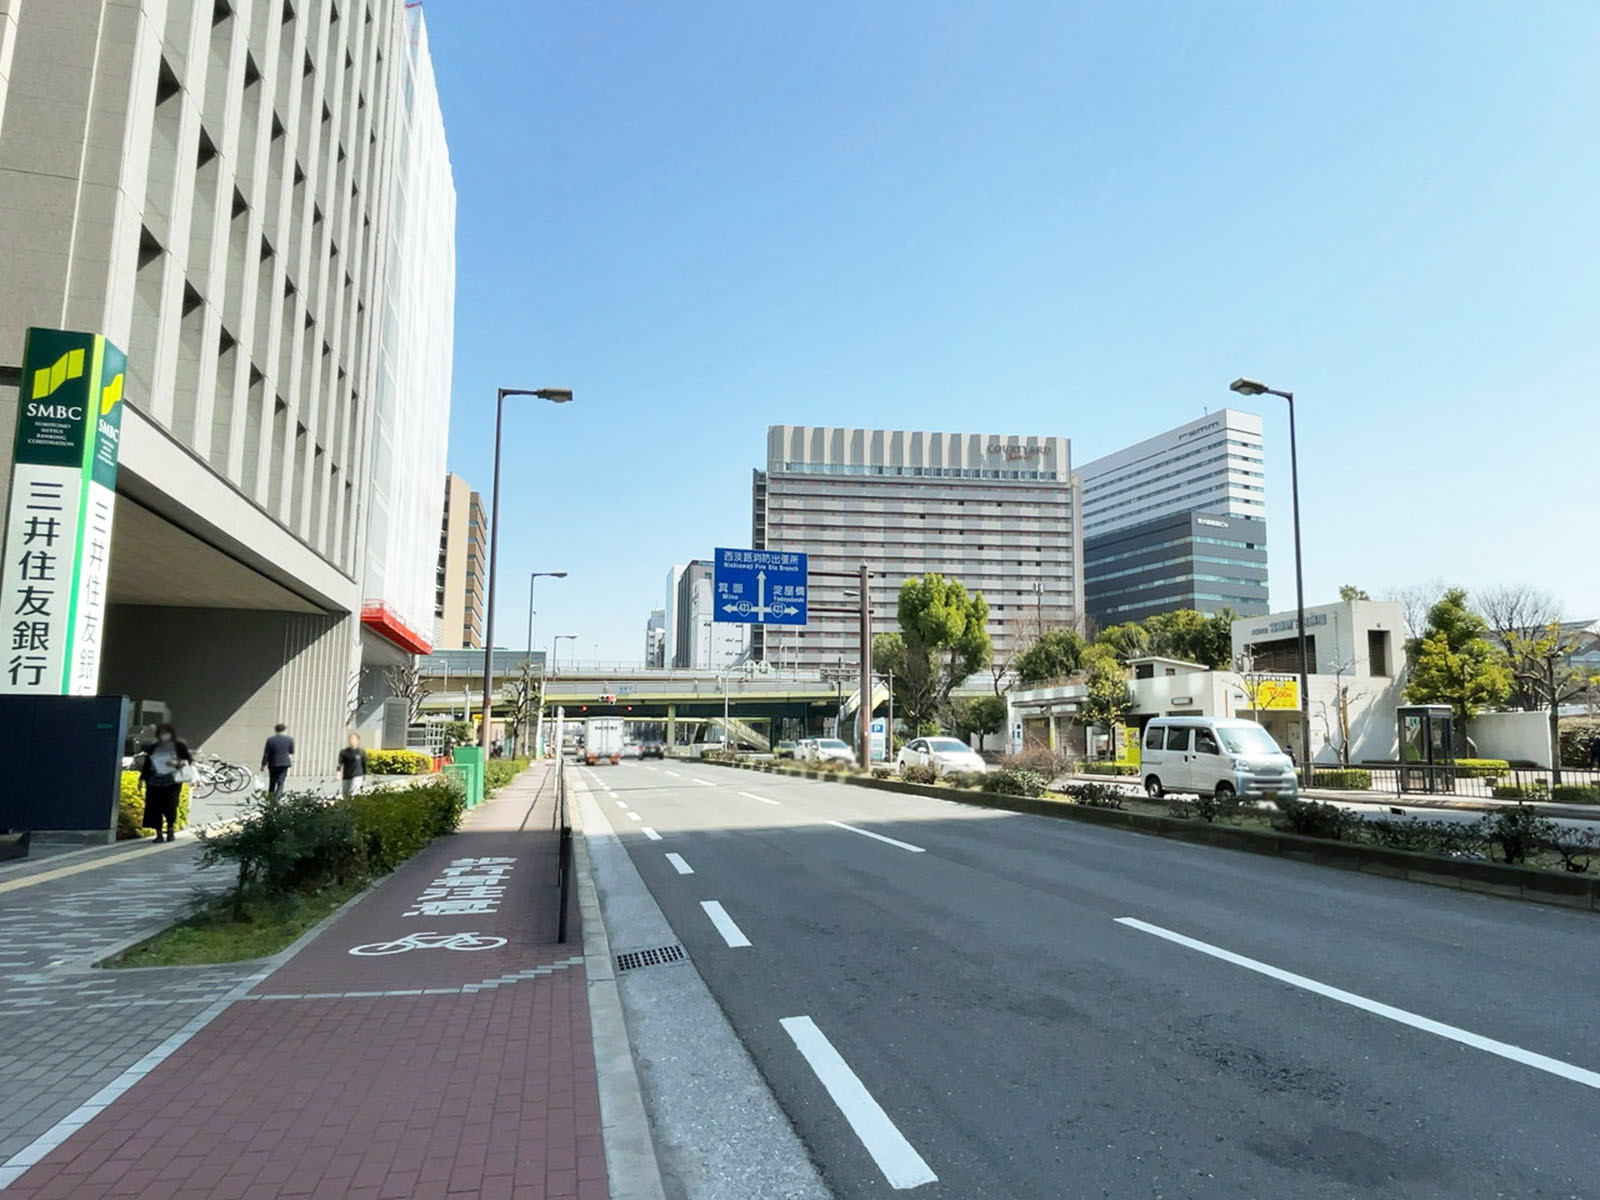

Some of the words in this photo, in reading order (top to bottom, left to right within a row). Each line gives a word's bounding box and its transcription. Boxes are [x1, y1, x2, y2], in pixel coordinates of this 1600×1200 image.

[27, 403, 82, 421] SMBC
[98, 418, 120, 442] SMBC
[987, 444, 1051, 456] COURTYARD
[8, 481, 64, 686] 三井住友銀行
